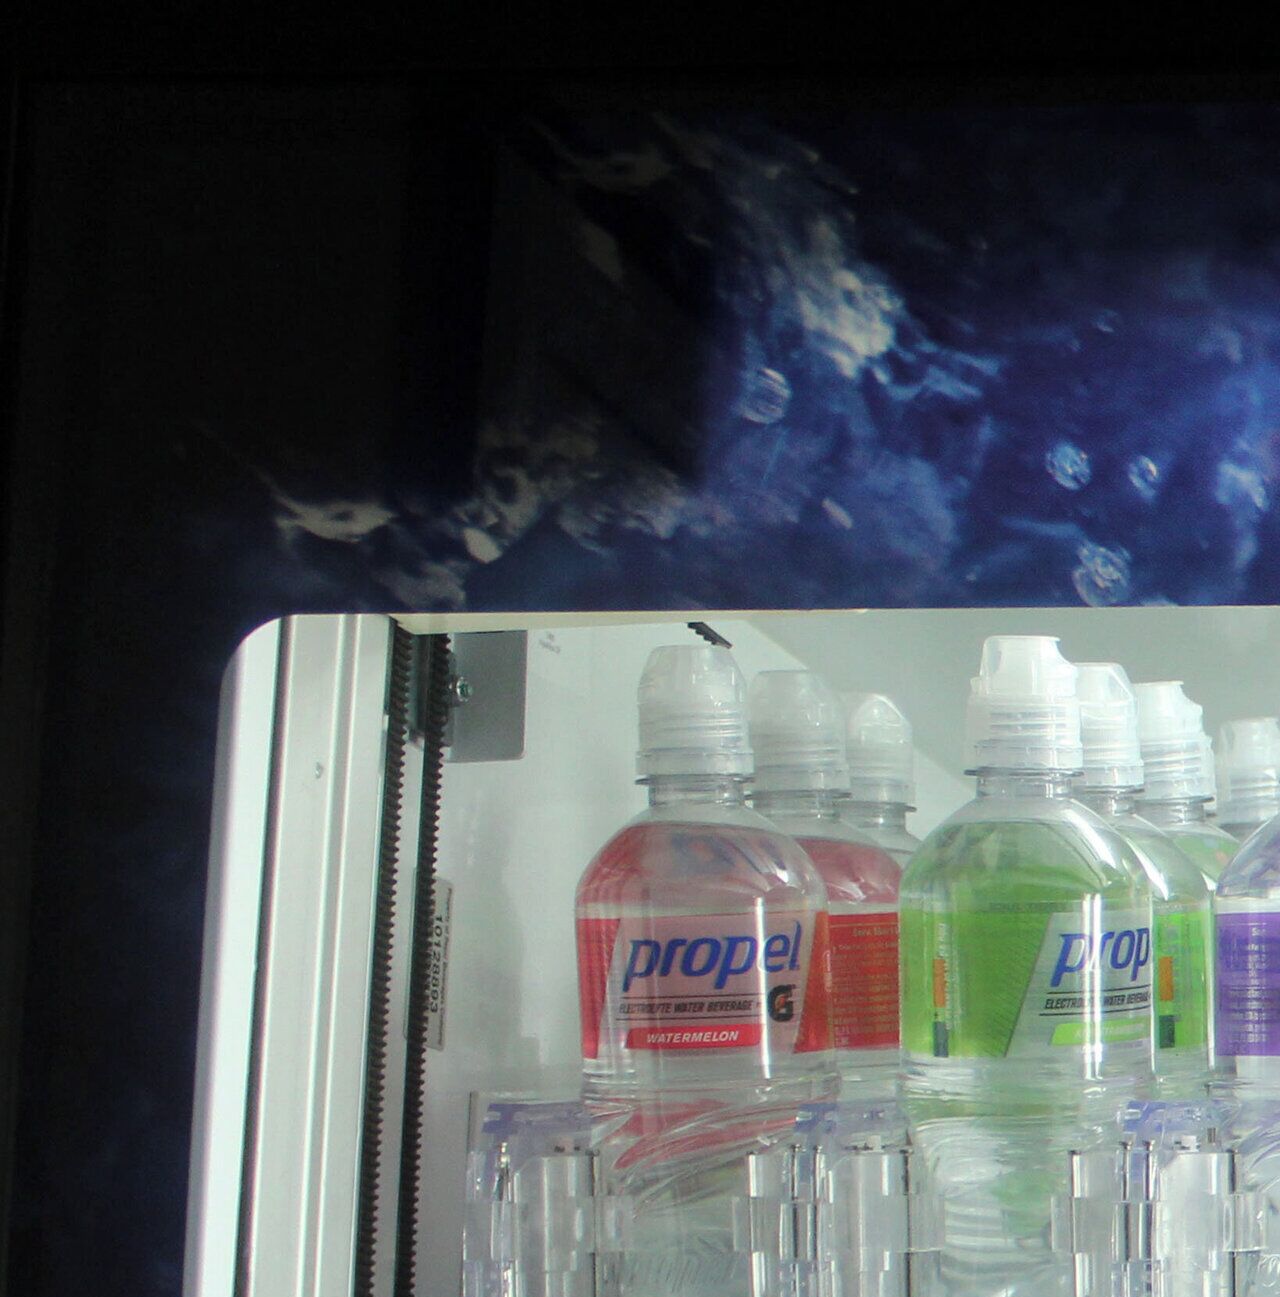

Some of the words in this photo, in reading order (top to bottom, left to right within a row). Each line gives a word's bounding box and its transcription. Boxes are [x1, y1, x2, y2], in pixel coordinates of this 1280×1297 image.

[622, 920, 802, 993] propel
[1050, 927, 1150, 988] prop
[673, 1001, 704, 1014] WATER
[706, 1000, 753, 1013] BEVERAGE
[646, 1030, 740, 1044] WATERMELON
